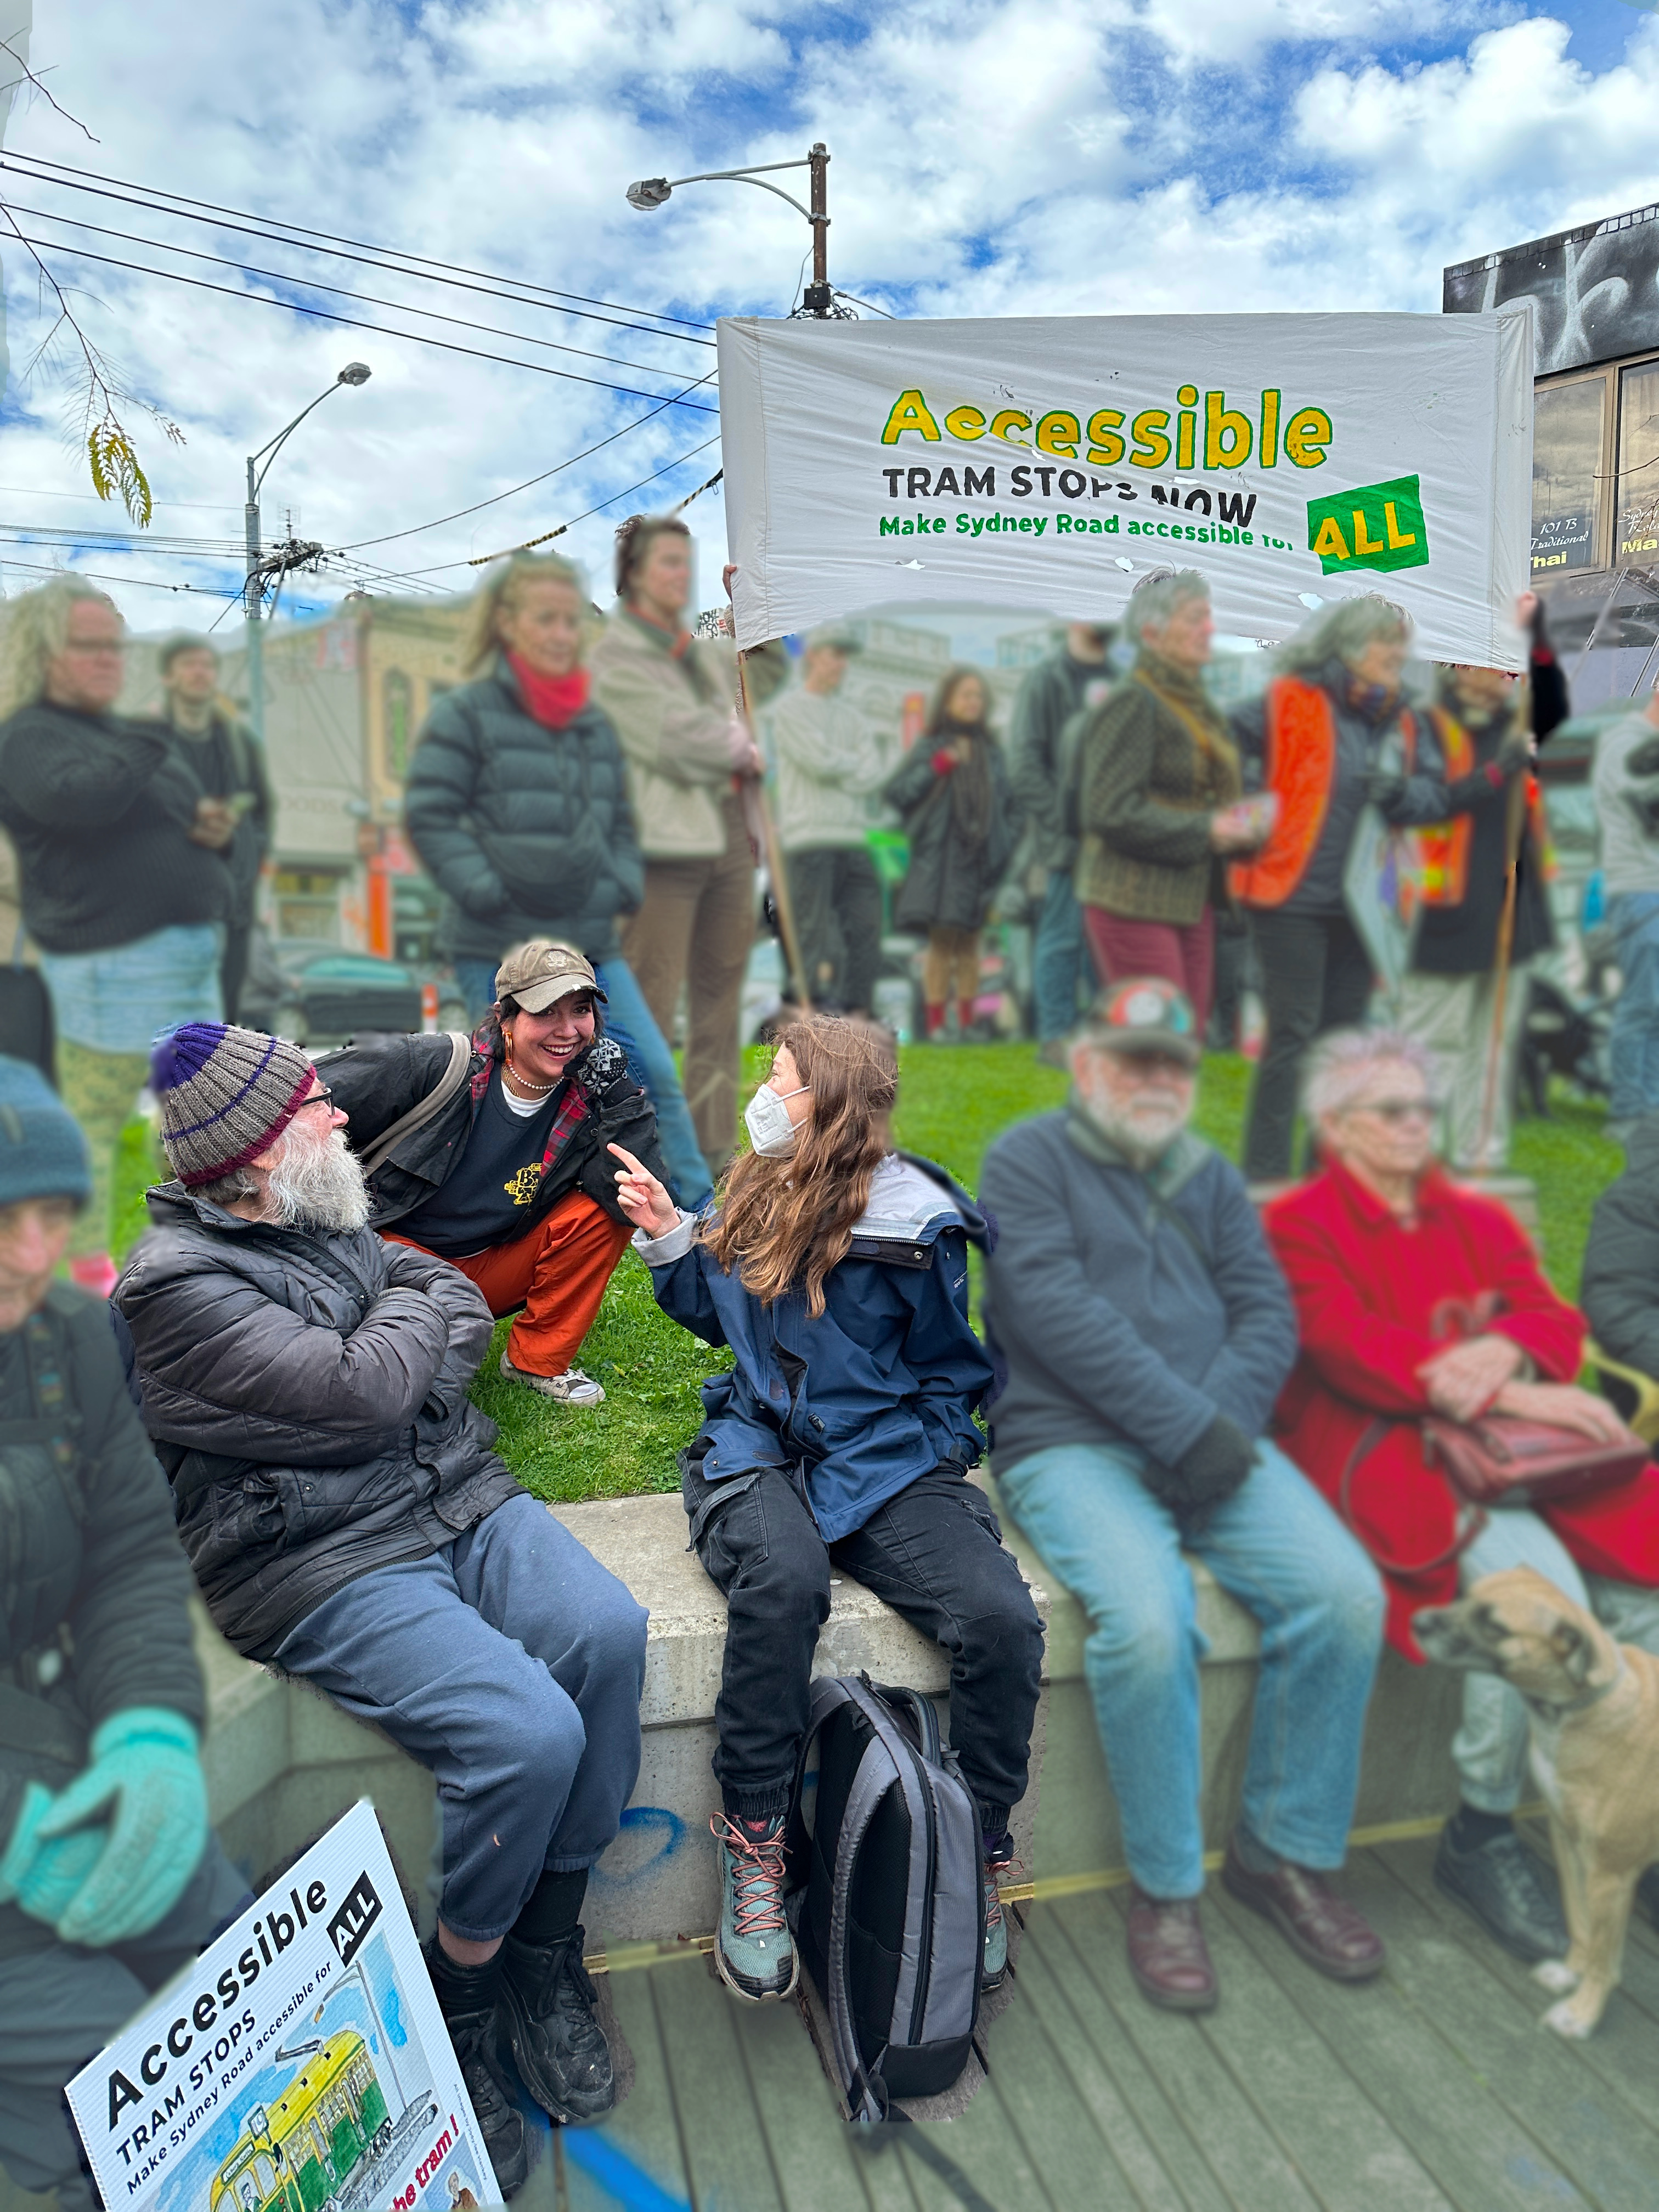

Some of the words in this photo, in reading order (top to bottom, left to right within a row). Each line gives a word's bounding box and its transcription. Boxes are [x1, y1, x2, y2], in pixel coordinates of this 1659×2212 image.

[881, 385, 1333, 470] Accessible
[883, 466, 995, 497] TRAM
[1152, 485, 1257, 527] NOW
[1540, 520, 1562, 535] 101
[1565, 518, 1577, 530] B
[880, 514, 946, 536] Make
[956, 512, 1048, 537] Sydney
[1057, 514, 1119, 534] Road
[1127, 522, 1254, 545] accessible
[1313, 501, 1416, 561] ALL
[1531, 531, 1589, 550] Traditional
[1622, 538, 1659, 554] Ma
[109, 1881, 327, 2132] Accessible
[127, 2147, 167, 2195] Make
[170, 2087, 218, 2147] Sydney
[221, 2046, 253, 2089] Road
[256, 1983, 314, 2051] accessible
[315, 1961, 331, 1983] for
[336, 1892, 375, 1958] ALL
[116, 2084, 185, 2166] TRAM
[189, 2008, 255, 2091] STOPS
[390, 2183, 416, 2209] he
